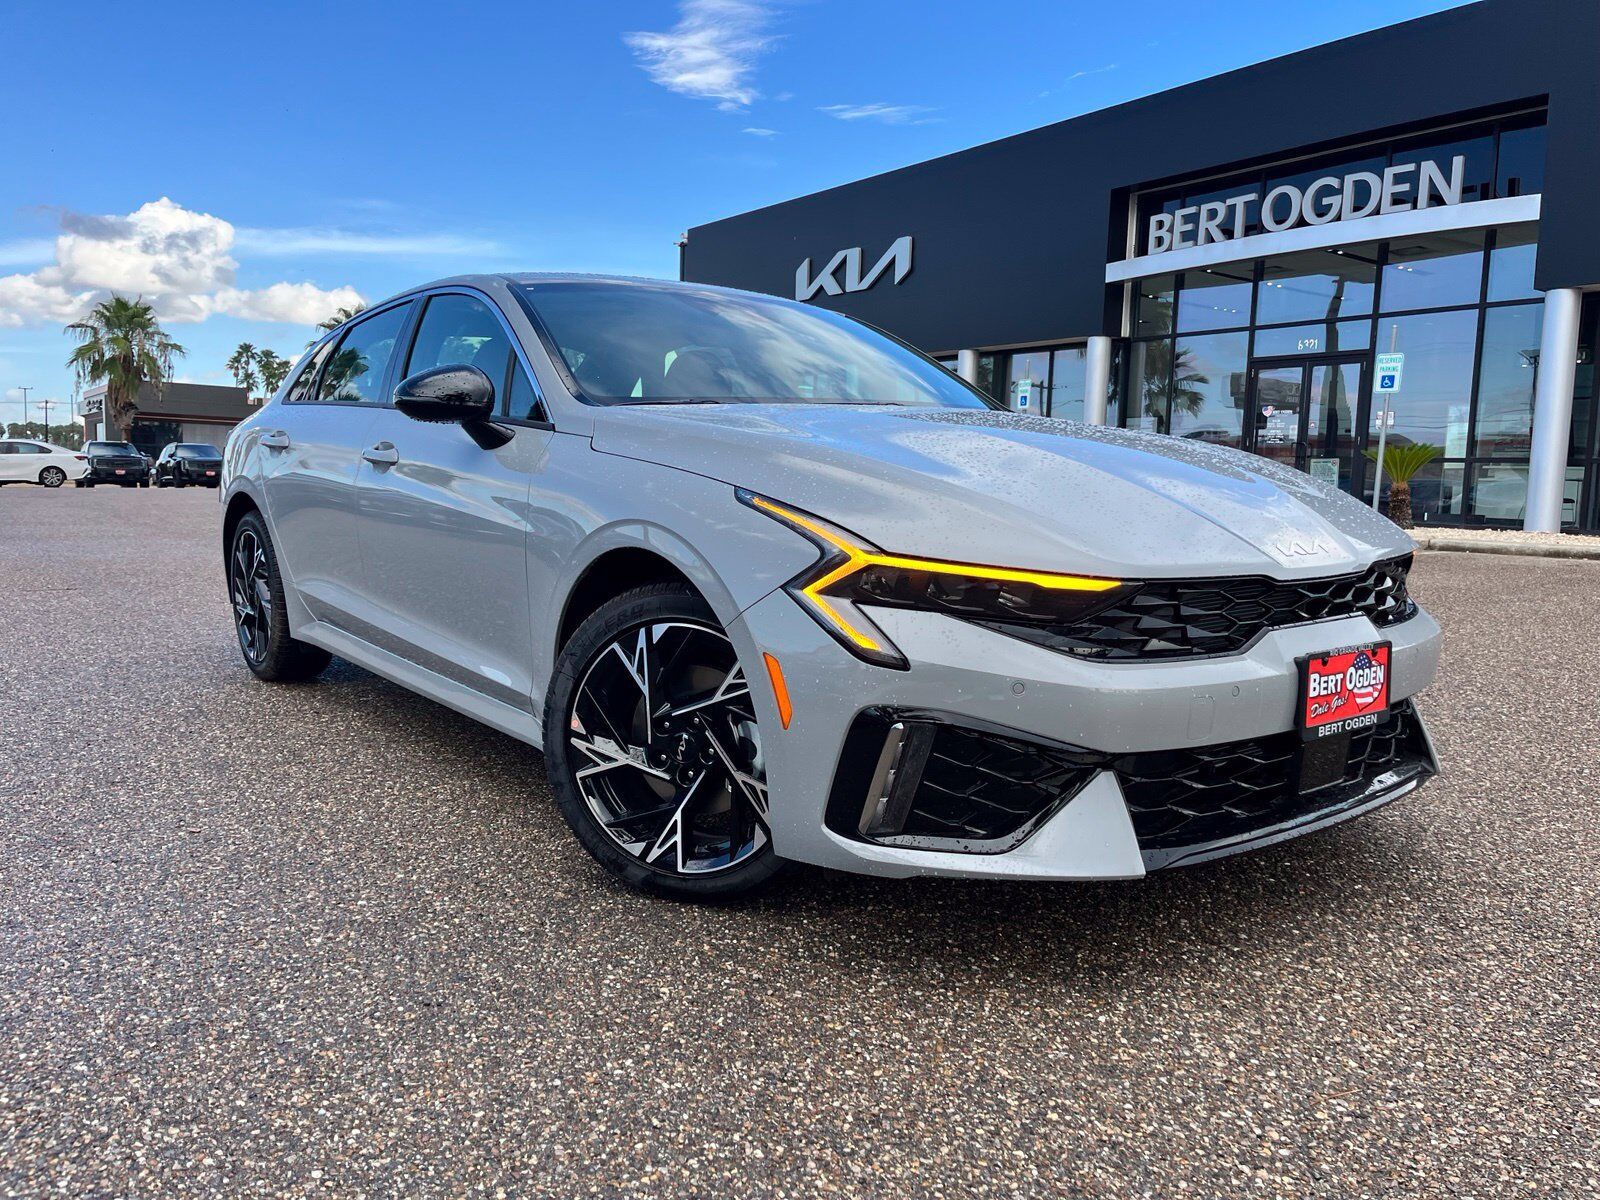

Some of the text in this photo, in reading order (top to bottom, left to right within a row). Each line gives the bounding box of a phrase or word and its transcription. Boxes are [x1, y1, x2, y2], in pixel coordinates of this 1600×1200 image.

[1148, 155, 1466, 255] BERT OGDEN
[795, 235, 914, 302] KIA
[1378, 356, 1402, 364] RESERVED
[1309, 665, 1384, 697] BERT OGDEN
[1318, 713, 1377, 737] BERT OGDEN
